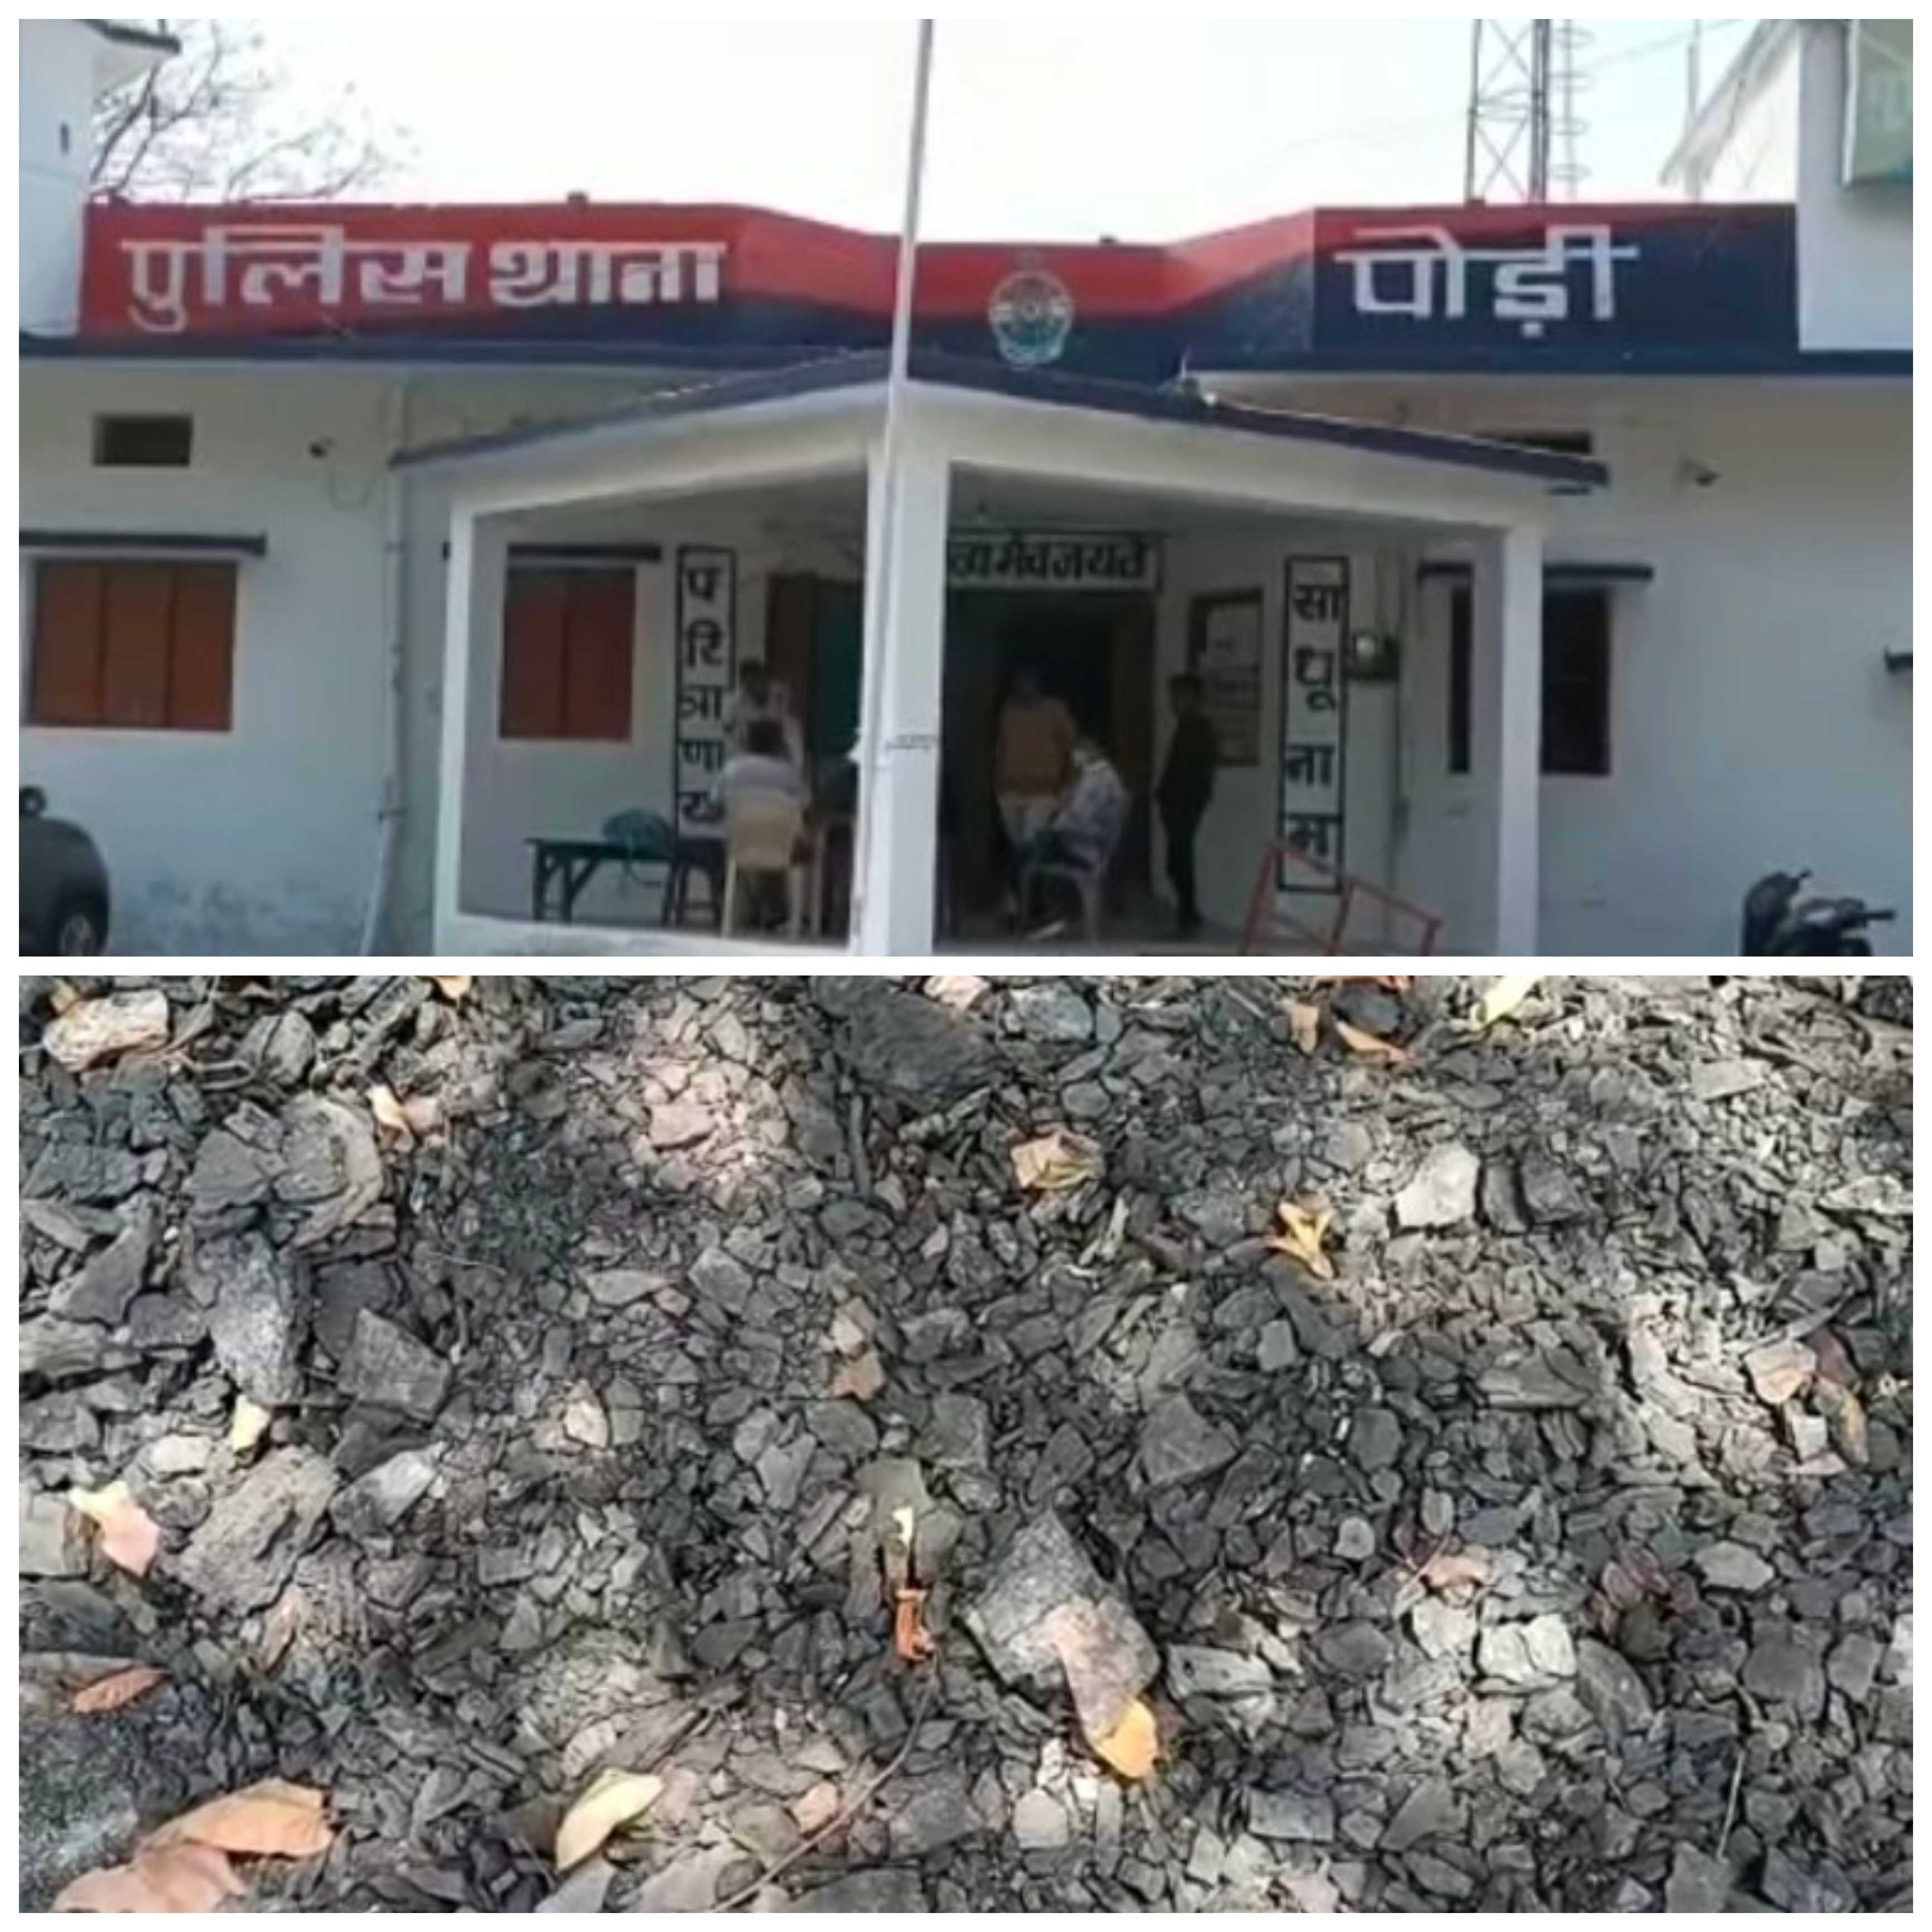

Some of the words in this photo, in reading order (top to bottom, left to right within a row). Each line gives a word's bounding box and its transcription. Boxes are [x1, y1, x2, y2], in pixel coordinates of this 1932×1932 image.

[121, 225, 472, 333] पुलिस
[490, 240, 726, 307] थाना
[1333, 224, 1640, 336] पोड़ी
